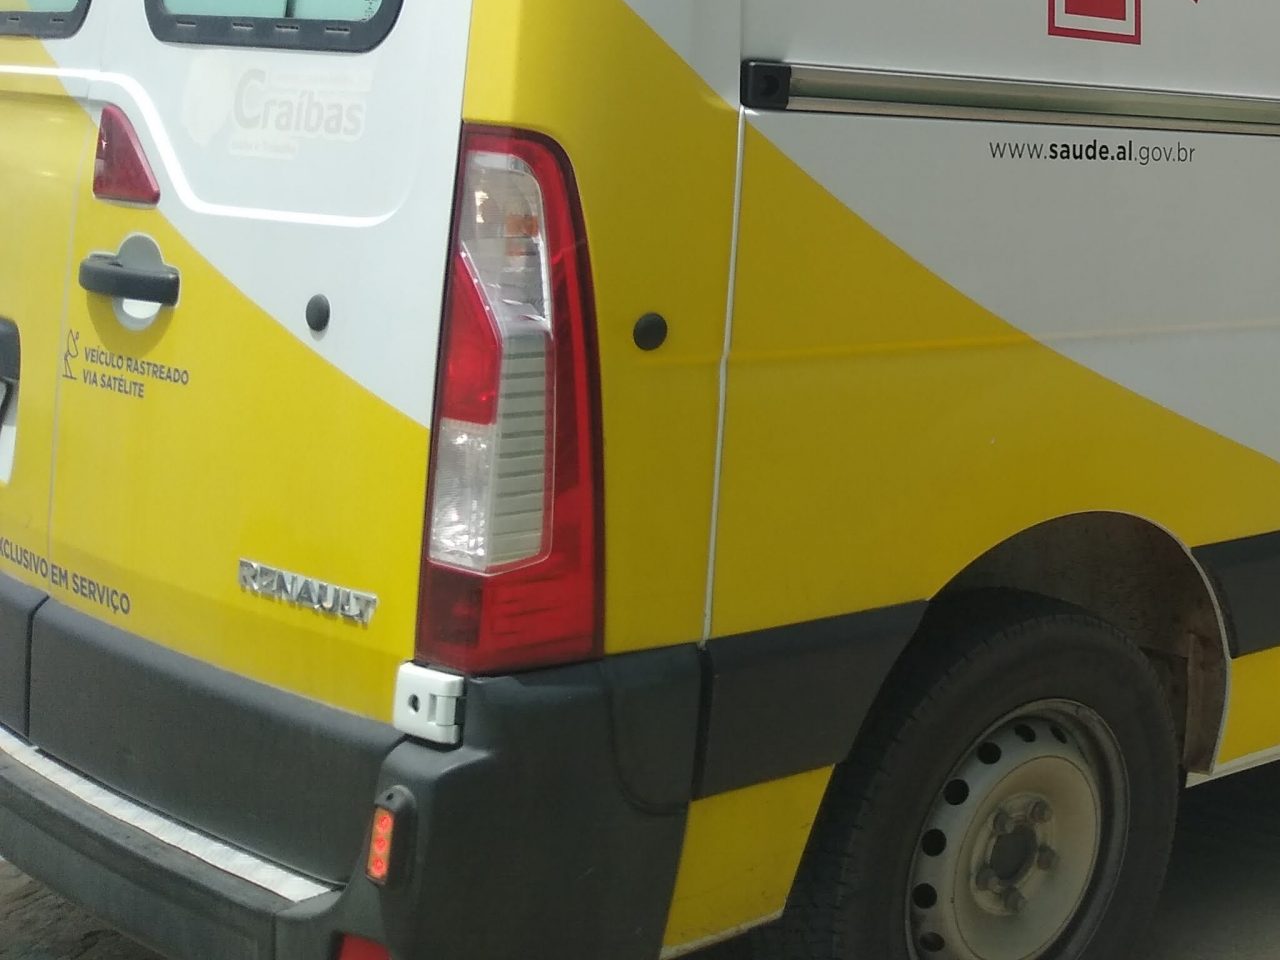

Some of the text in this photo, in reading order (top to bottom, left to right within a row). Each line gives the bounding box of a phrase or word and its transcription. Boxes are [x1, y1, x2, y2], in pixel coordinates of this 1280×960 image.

[989, 139, 1196, 166] www.saude.al.gov.br
[82, 369, 145, 398] VIA SATÉLITE
[84, 345, 189, 385] VEÍCULO RASTREADO
[51, 564, 69, 590] EM
[72, 572, 131, 614] SERVIÇO
[239, 557, 377, 627] RENAULT
